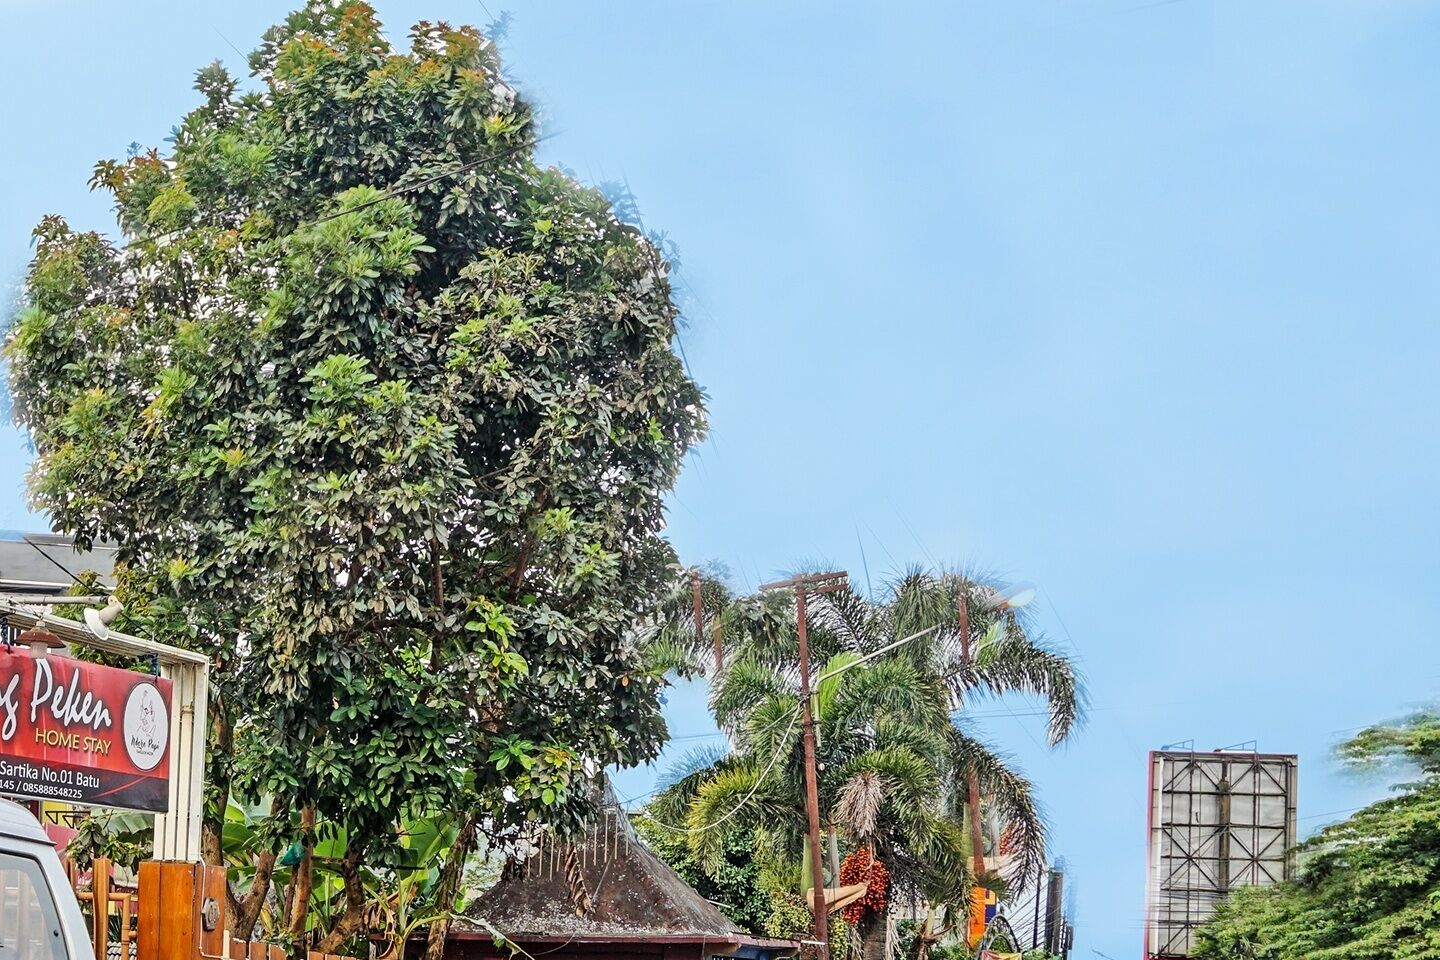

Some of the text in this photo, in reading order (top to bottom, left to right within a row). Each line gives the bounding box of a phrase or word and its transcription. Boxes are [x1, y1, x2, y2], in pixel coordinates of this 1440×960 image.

[30, 657, 112, 731] Peken
[35, 728, 112, 755] HOME STAY
[0, 760, 38, 780] Sartika
[41, 766, 73, 785] No.01
[76, 772, 100, 789] Batu
[22, 783, 83, 799] 085888548225
